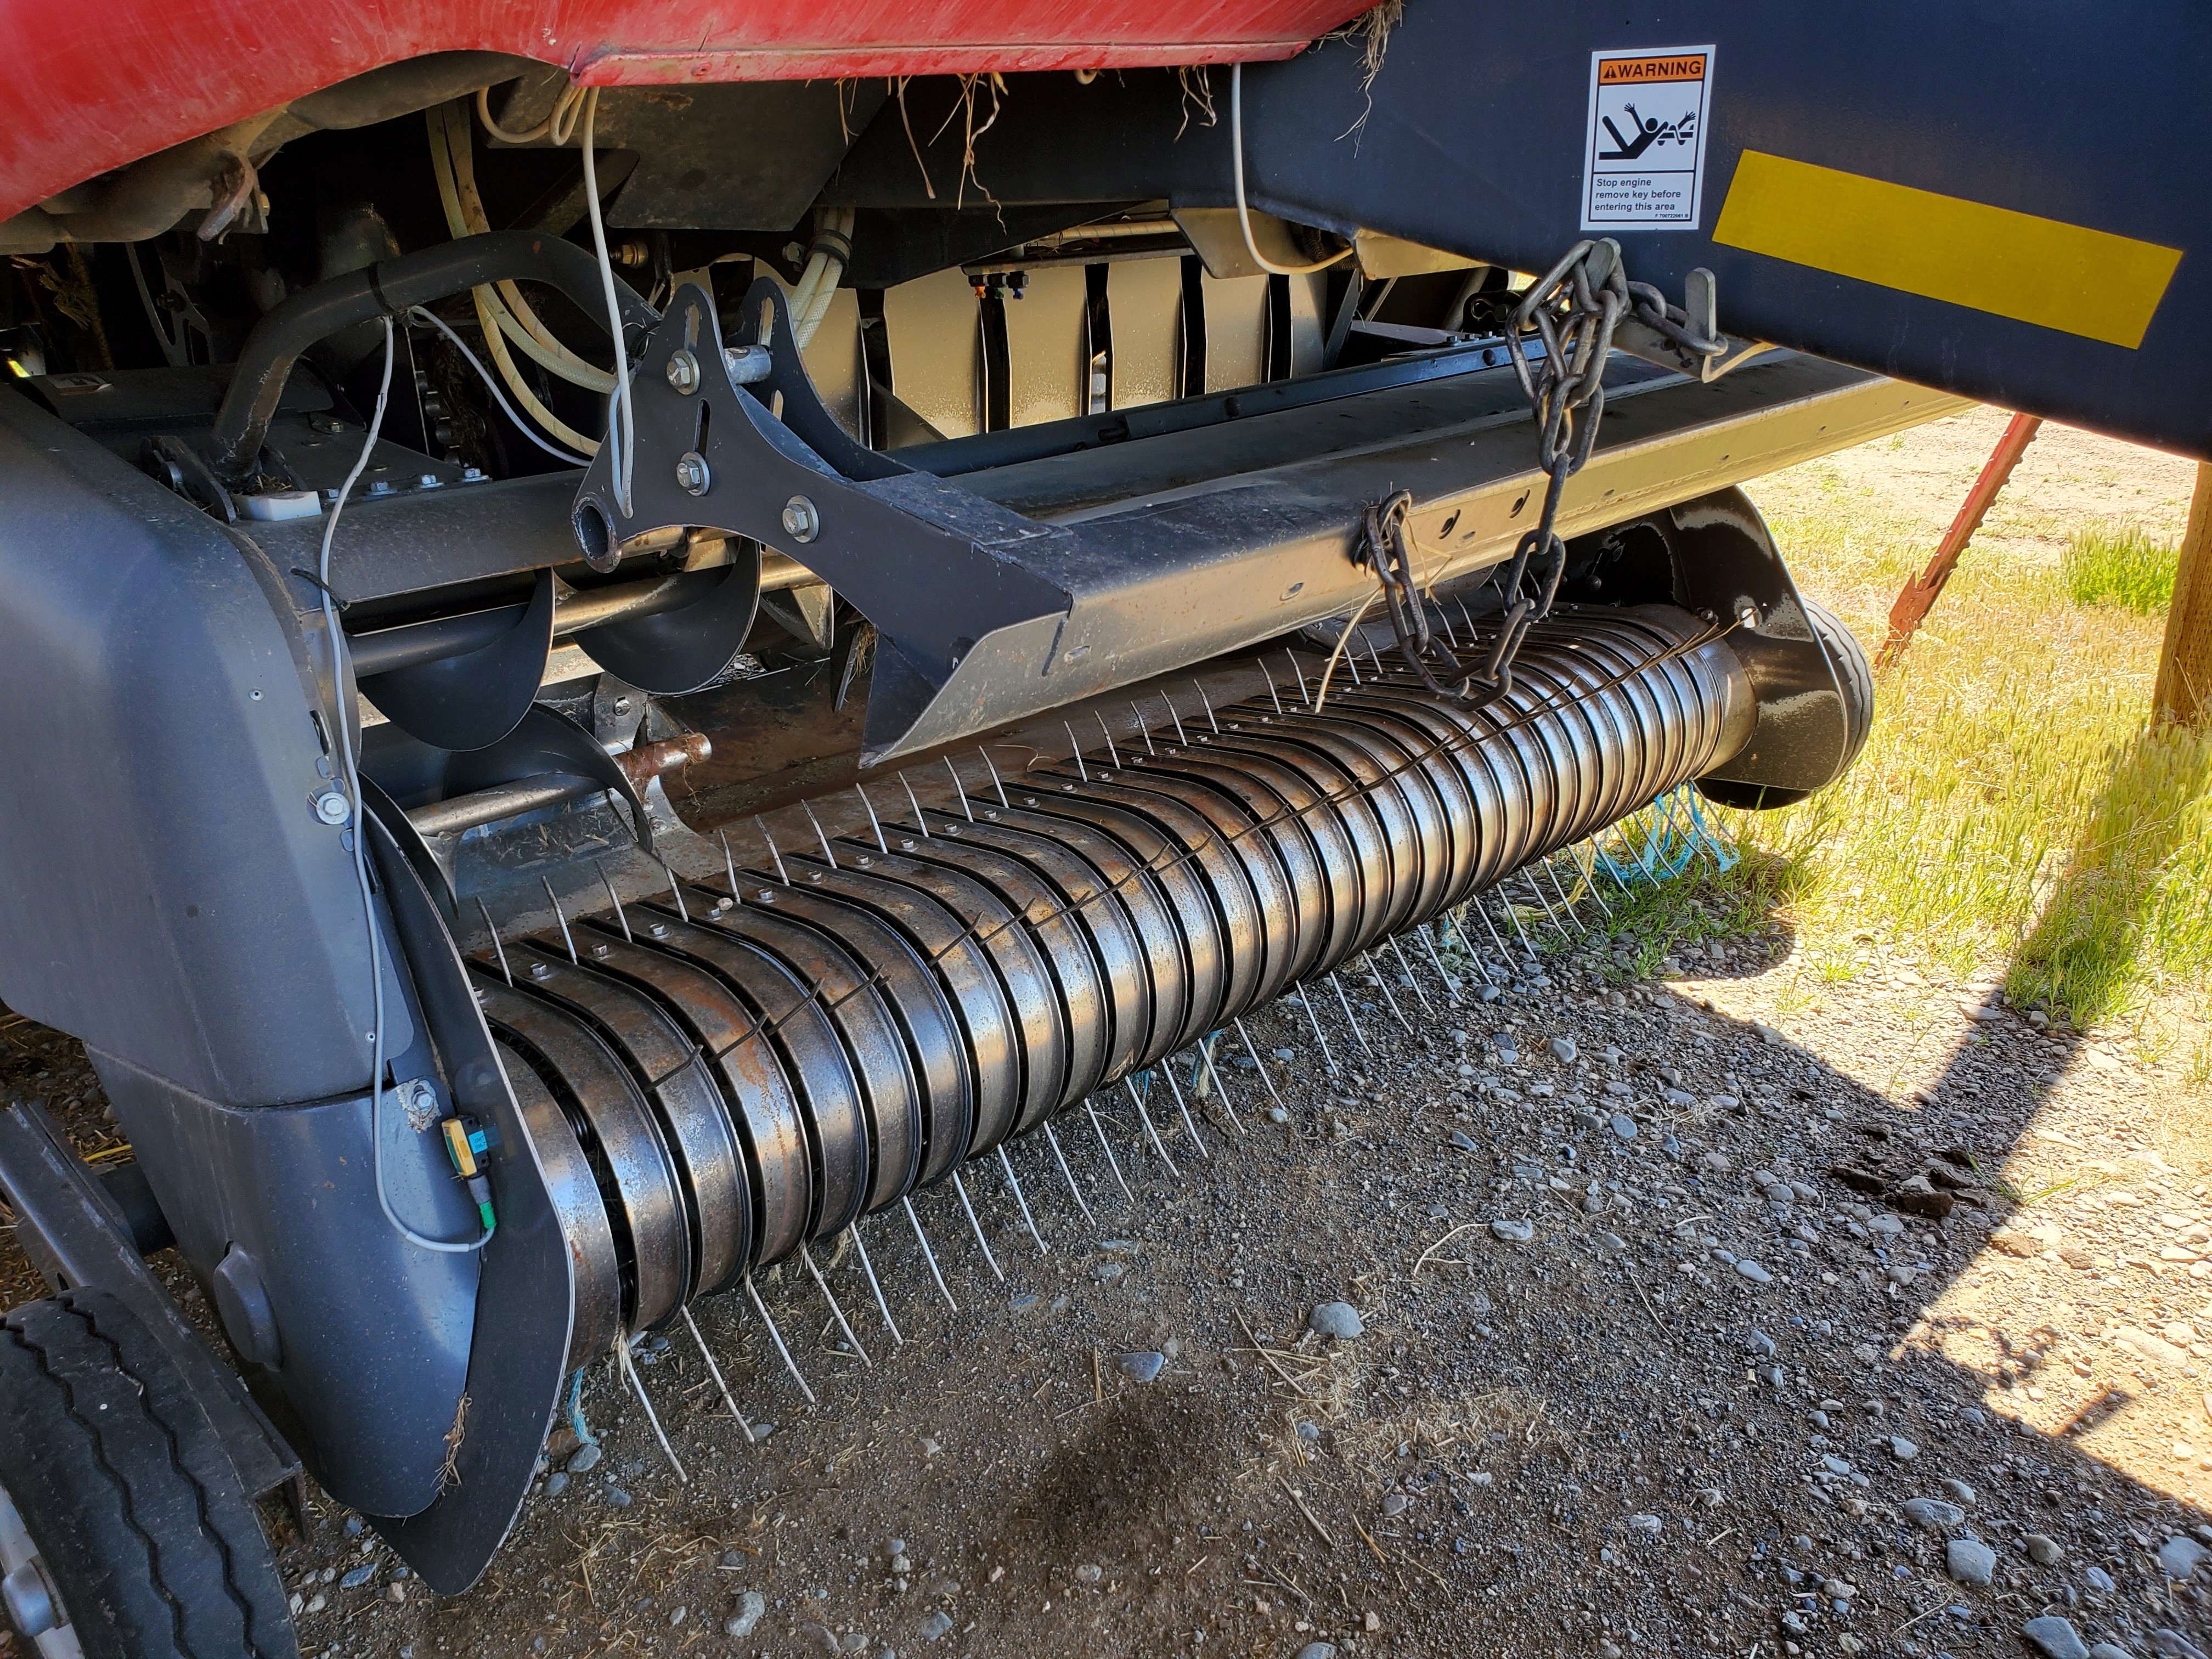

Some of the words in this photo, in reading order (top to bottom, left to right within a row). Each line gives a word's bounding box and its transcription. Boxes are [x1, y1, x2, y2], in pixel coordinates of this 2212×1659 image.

[1618, 60, 1701, 78] WARNING
[1596, 178, 1617, 188] Stop
[1620, 178, 1651, 188] engine
[1632, 190, 1649, 200] key
[1651, 190, 1681, 198] before
[1595, 202, 1632, 212] entering
[1635, 202, 1652, 210] this
